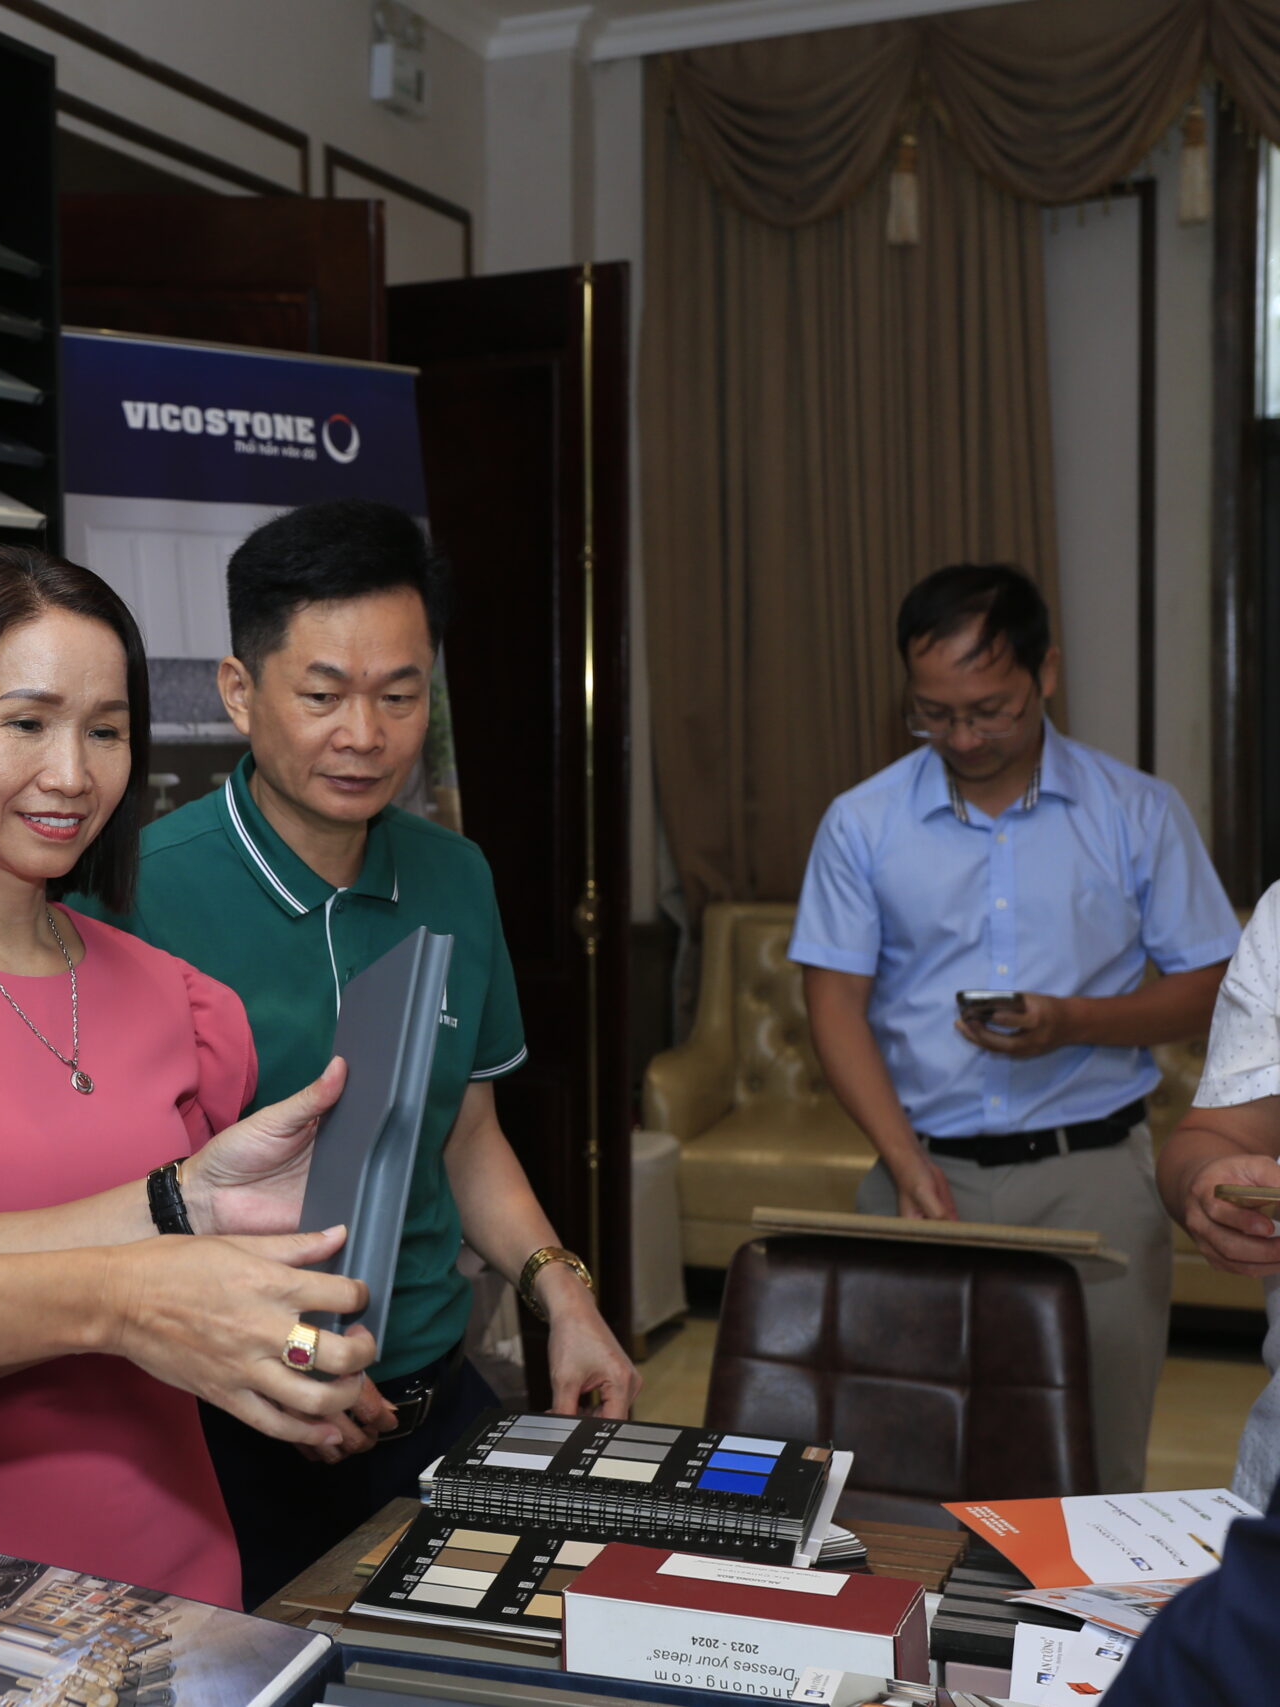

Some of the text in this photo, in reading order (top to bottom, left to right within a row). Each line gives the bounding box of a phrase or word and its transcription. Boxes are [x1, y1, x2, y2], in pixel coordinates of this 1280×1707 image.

[121, 401, 316, 444] VICOSTONE
[691, 1635, 719, 1649] 2024
[731, 1641, 759, 1655] 2023
[696, 1655, 730, 1669] your
[1041, 1662, 1052, 1672] AN
